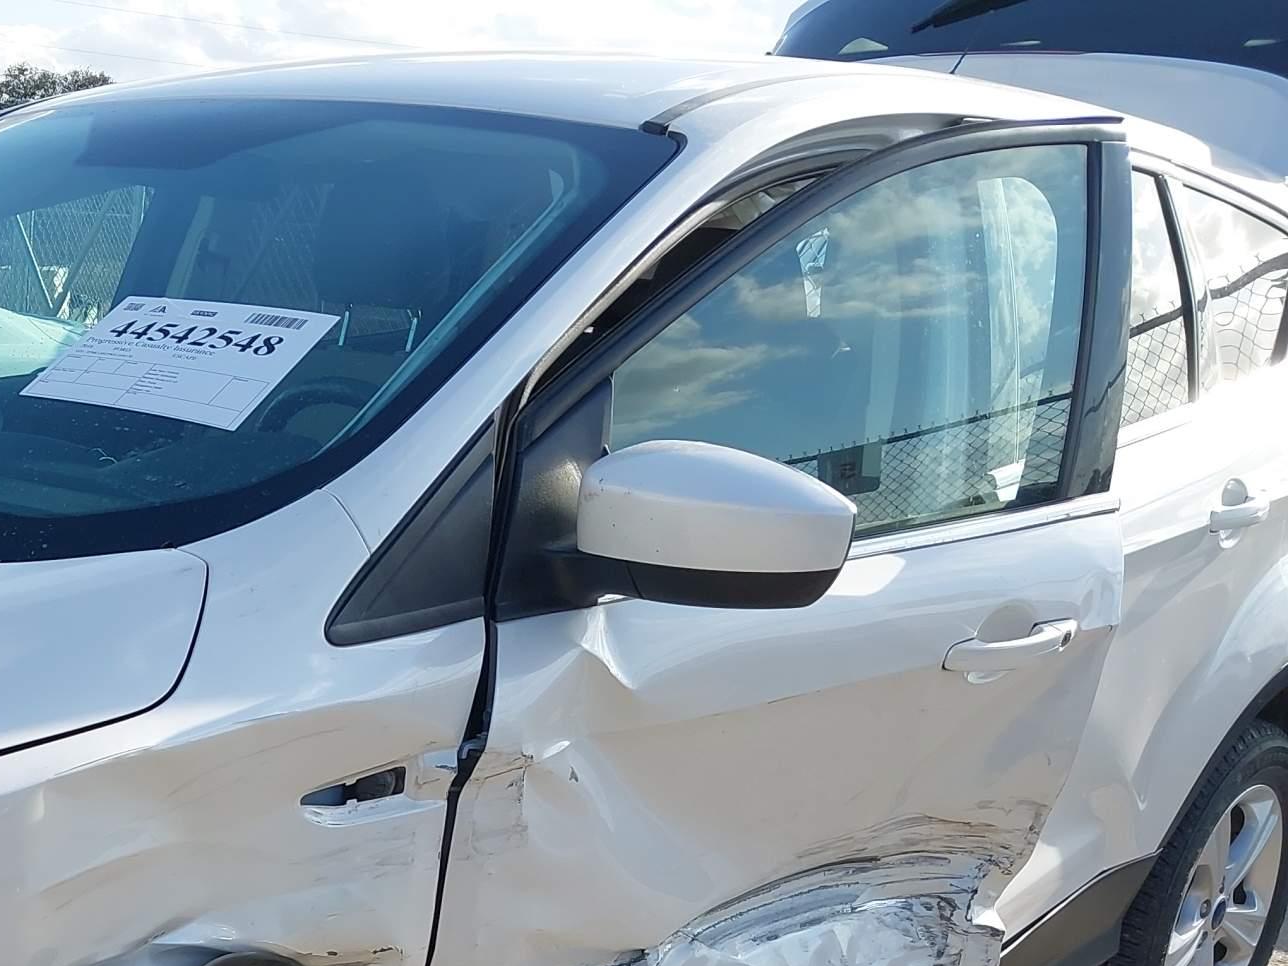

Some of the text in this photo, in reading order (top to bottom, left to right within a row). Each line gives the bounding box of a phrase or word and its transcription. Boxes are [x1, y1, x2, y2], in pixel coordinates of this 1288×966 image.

[86, 336, 136, 347] Progressive
[134, 340, 173, 351] Casualty
[173, 344, 216, 357] Insurance
[109, 319, 285, 357] 44542548
